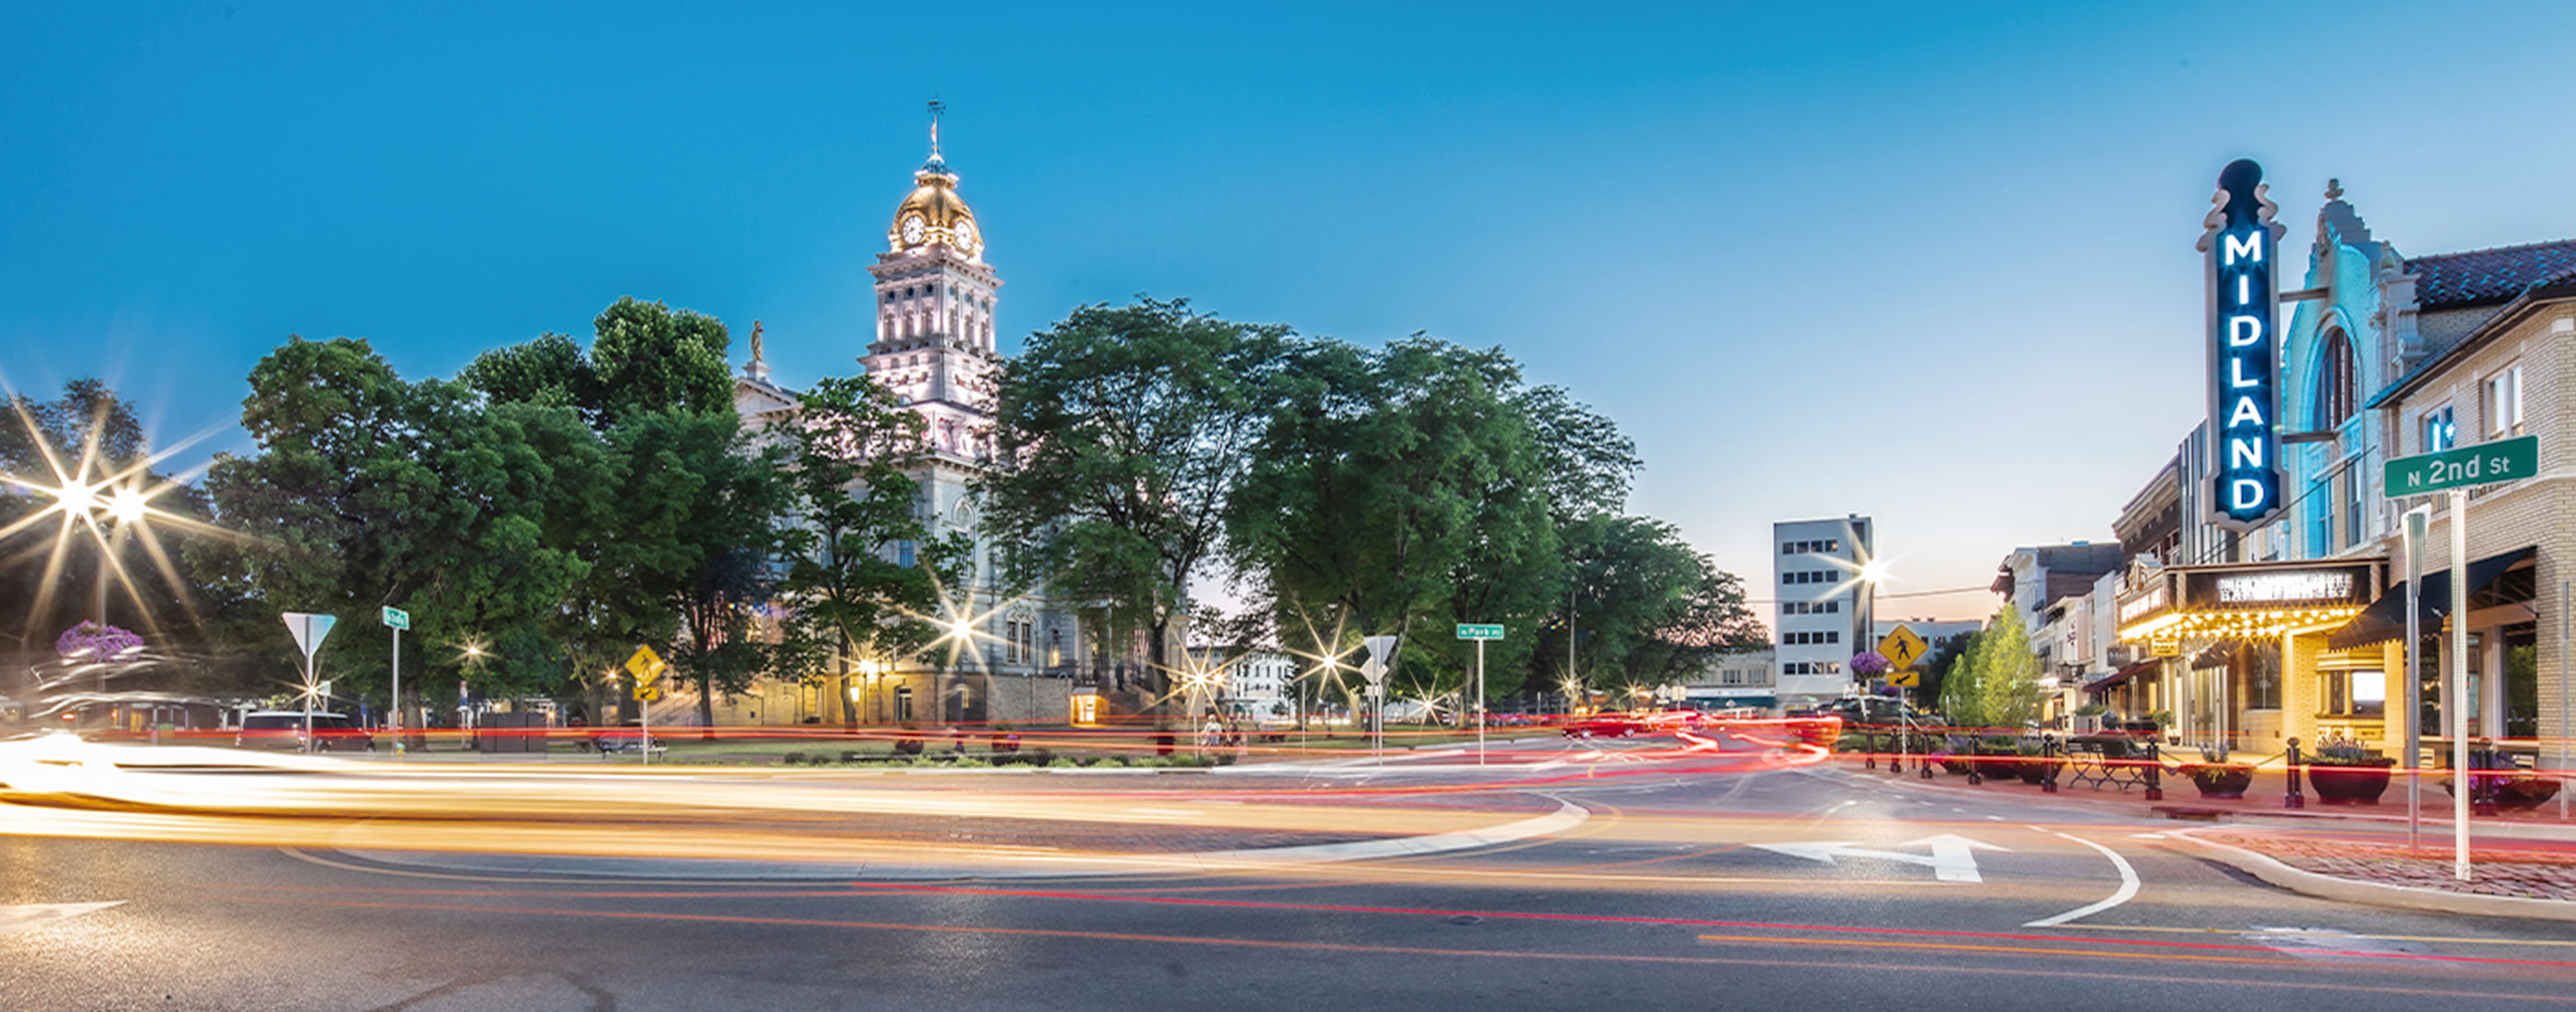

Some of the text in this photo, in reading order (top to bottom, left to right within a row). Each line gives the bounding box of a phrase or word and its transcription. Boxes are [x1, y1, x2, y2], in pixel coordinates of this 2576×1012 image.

[2225, 231, 2264, 510] MIDLAND
[2408, 454, 2510, 487] N 2nd St
